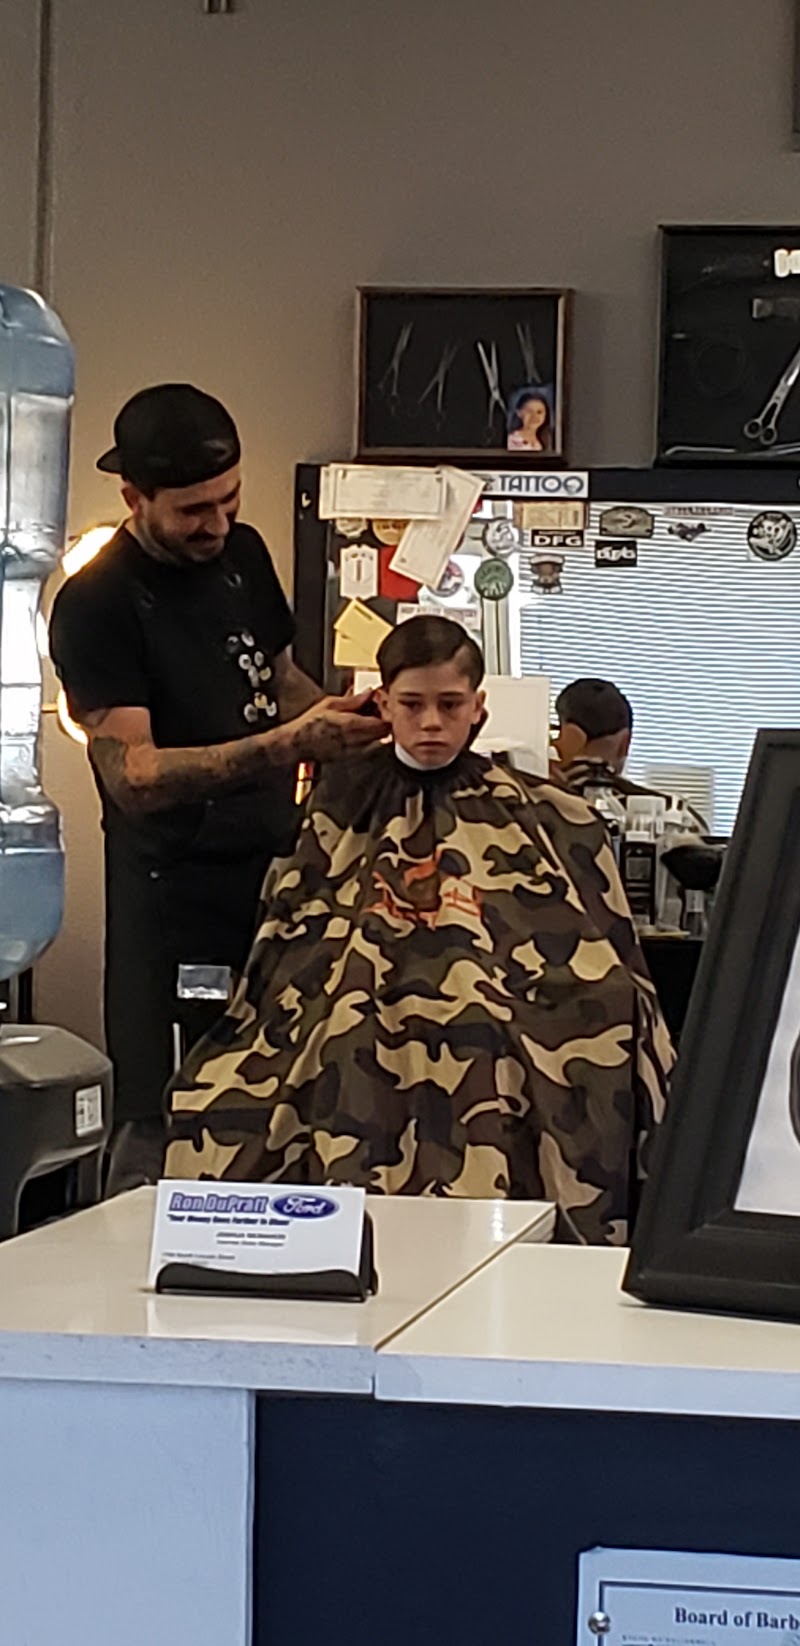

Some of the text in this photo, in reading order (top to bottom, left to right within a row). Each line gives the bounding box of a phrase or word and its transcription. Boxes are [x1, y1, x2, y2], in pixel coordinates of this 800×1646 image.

[499, 475, 584, 493] TATTOO
[534, 535, 582, 546] DFG
[169, 1193, 204, 1211] Ron
[283, 1195, 326, 1214] Ford
[675, 1607, 800, 1630] Board of Barb
